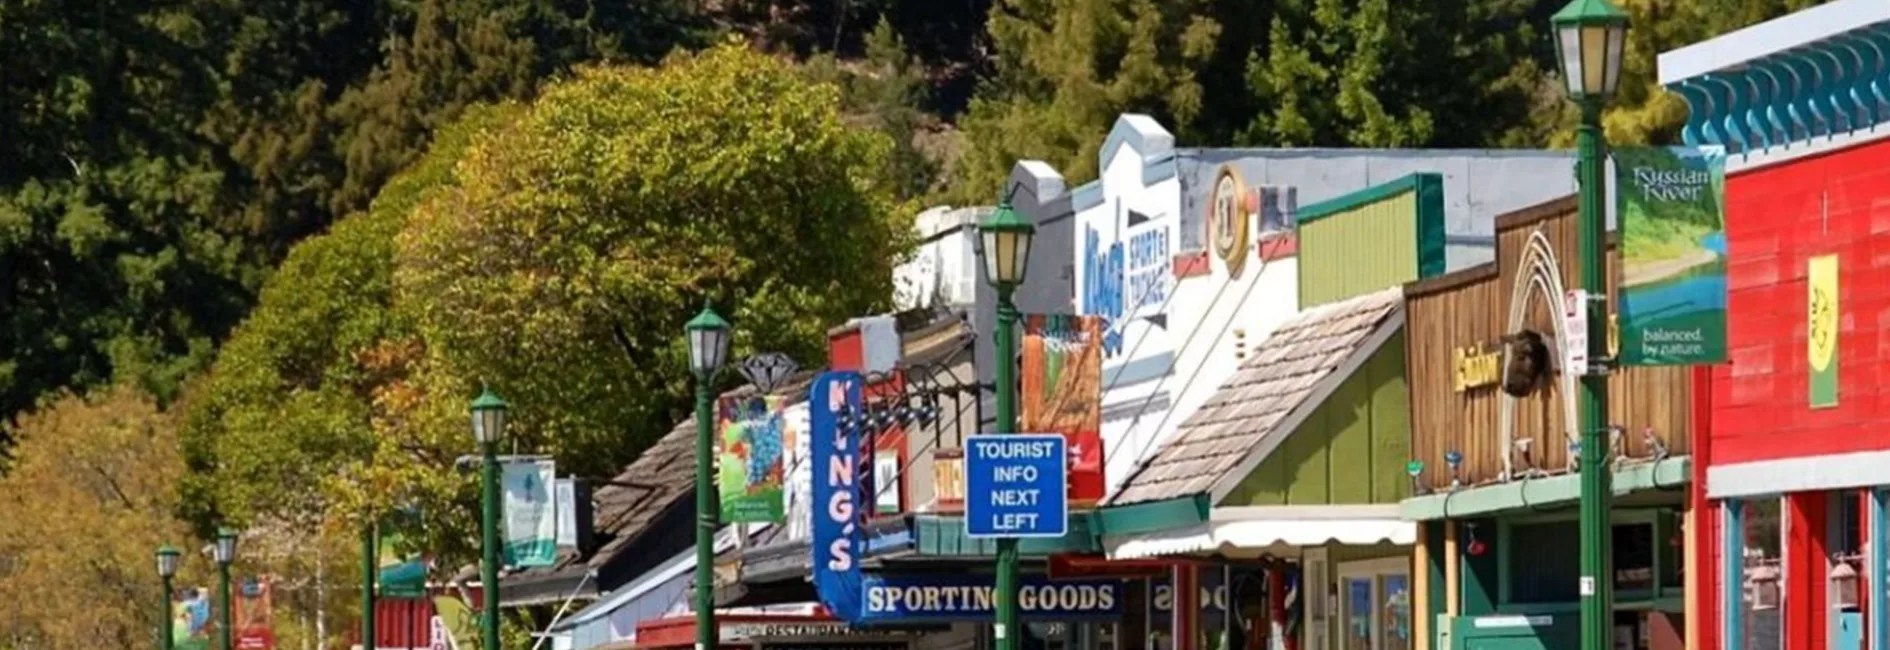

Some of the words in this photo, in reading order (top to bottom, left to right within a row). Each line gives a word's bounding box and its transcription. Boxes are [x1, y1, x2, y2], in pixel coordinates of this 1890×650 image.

[1633, 165, 1708, 186] Russian
[1643, 184, 1702, 202] River
[1643, 328, 1704, 342] balanced.
[975, 441, 1054, 459] TOURIST
[993, 464, 1038, 482] INFO
[991, 489, 1040, 506] NEXT
[992, 512, 1039, 530] LEFT
[1018, 585, 1115, 611] GOODS
